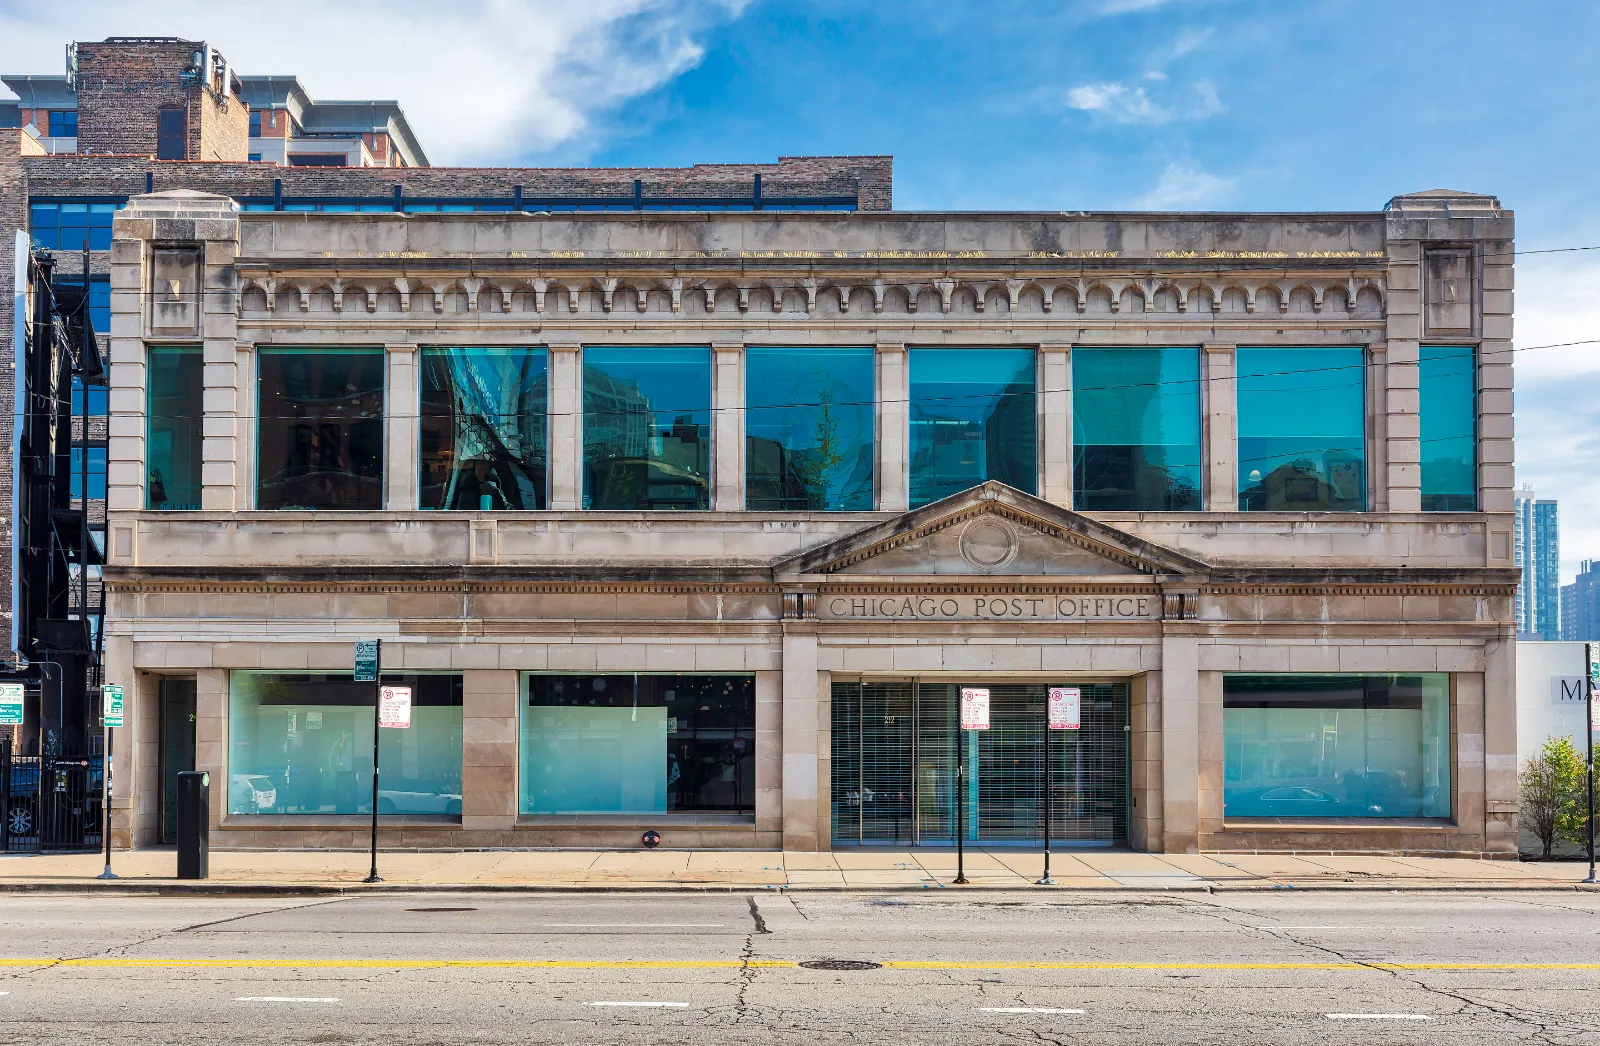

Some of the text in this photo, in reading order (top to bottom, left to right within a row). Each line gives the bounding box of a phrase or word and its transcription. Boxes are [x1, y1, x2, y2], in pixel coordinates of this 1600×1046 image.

[830, 597, 1150, 617] CHICAGO POST OFFICE
[884, 715, 895, 724] 212
